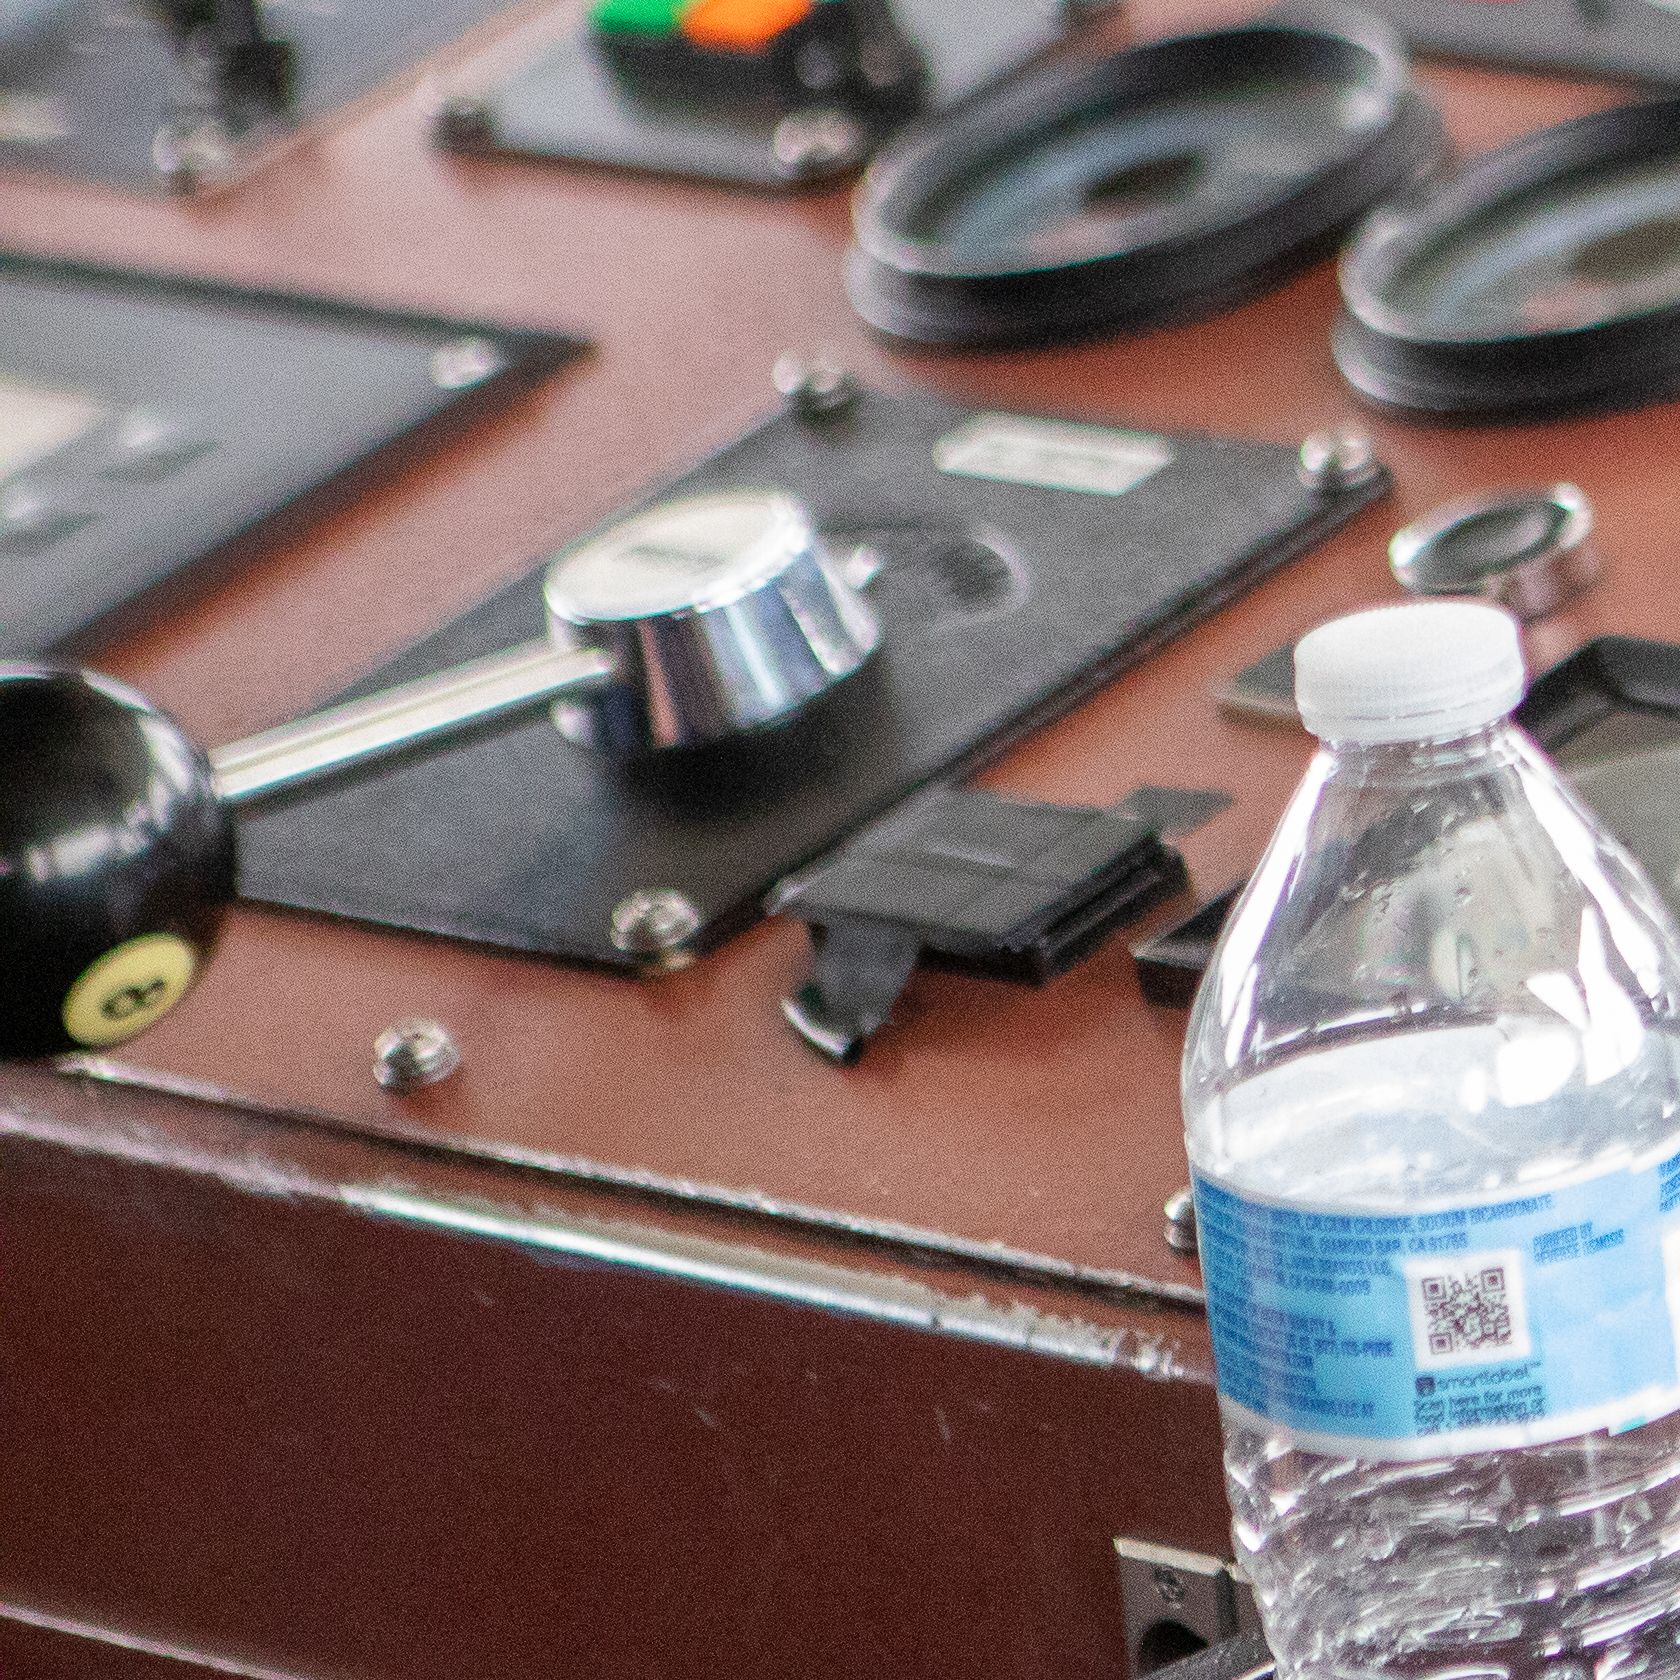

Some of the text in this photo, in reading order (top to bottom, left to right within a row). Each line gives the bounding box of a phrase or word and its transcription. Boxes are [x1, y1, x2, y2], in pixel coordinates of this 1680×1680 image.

[101, 976, 167, 1021] 8
[1416, 1208, 1467, 1230] SODIUM
[1468, 1193, 1553, 1225] BICARBONATE
[1407, 1236, 1426, 1254] CA
[1448, 1393, 1480, 1407] here
[1483, 1389, 1504, 1403] for
[1507, 1384, 1543, 1400] more
[1448, 1401, 1527, 1422] information
